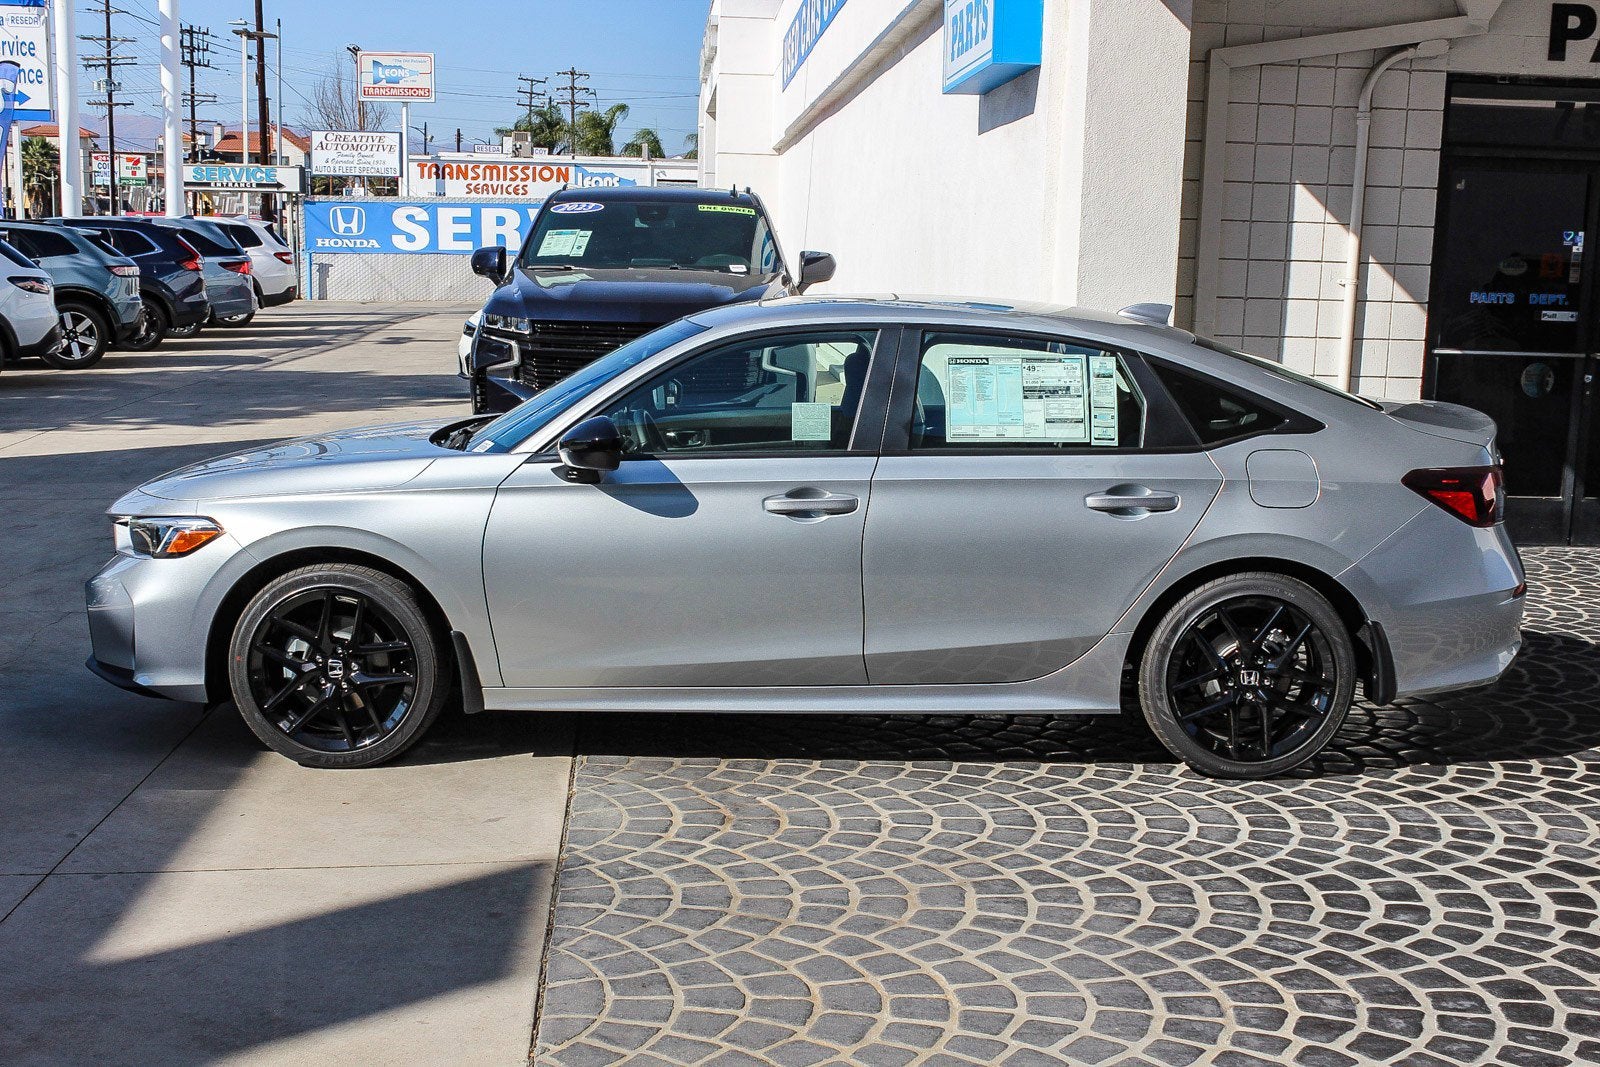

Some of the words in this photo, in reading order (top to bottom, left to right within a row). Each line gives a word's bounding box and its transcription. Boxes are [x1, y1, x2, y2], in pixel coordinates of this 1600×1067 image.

[10, 16, 39, 25] RESEDA
[950, 0, 988, 63] PARTS
[1548, 3, 1600, 63] P
[378, 66, 410, 79] LEONS
[364, 87, 429, 97] TRANSMISSIONS
[324, 132, 386, 143] CREATIVE
[314, 141, 397, 153] AUTOMOTIVE
[476, 145, 501, 153] RESEDA
[97, 162, 110, 170] COI
[314, 165, 331, 173] AUTO
[338, 166, 357, 174] FLEET
[358, 166, 397, 175] SPECIALISTS
[192, 166, 278, 183] SERVICE
[417, 163, 570, 183] TRANSMISSION
[465, 183, 528, 196] SERVICES
[720, 206, 754, 214] OWNER
[391, 206, 537, 251] SER
[315, 238, 381, 249] HONDA
[1470, 291, 1515, 305] PARTS
[1529, 293, 1570, 306] DEPT.
[1542, 312, 1558, 320] Pull
